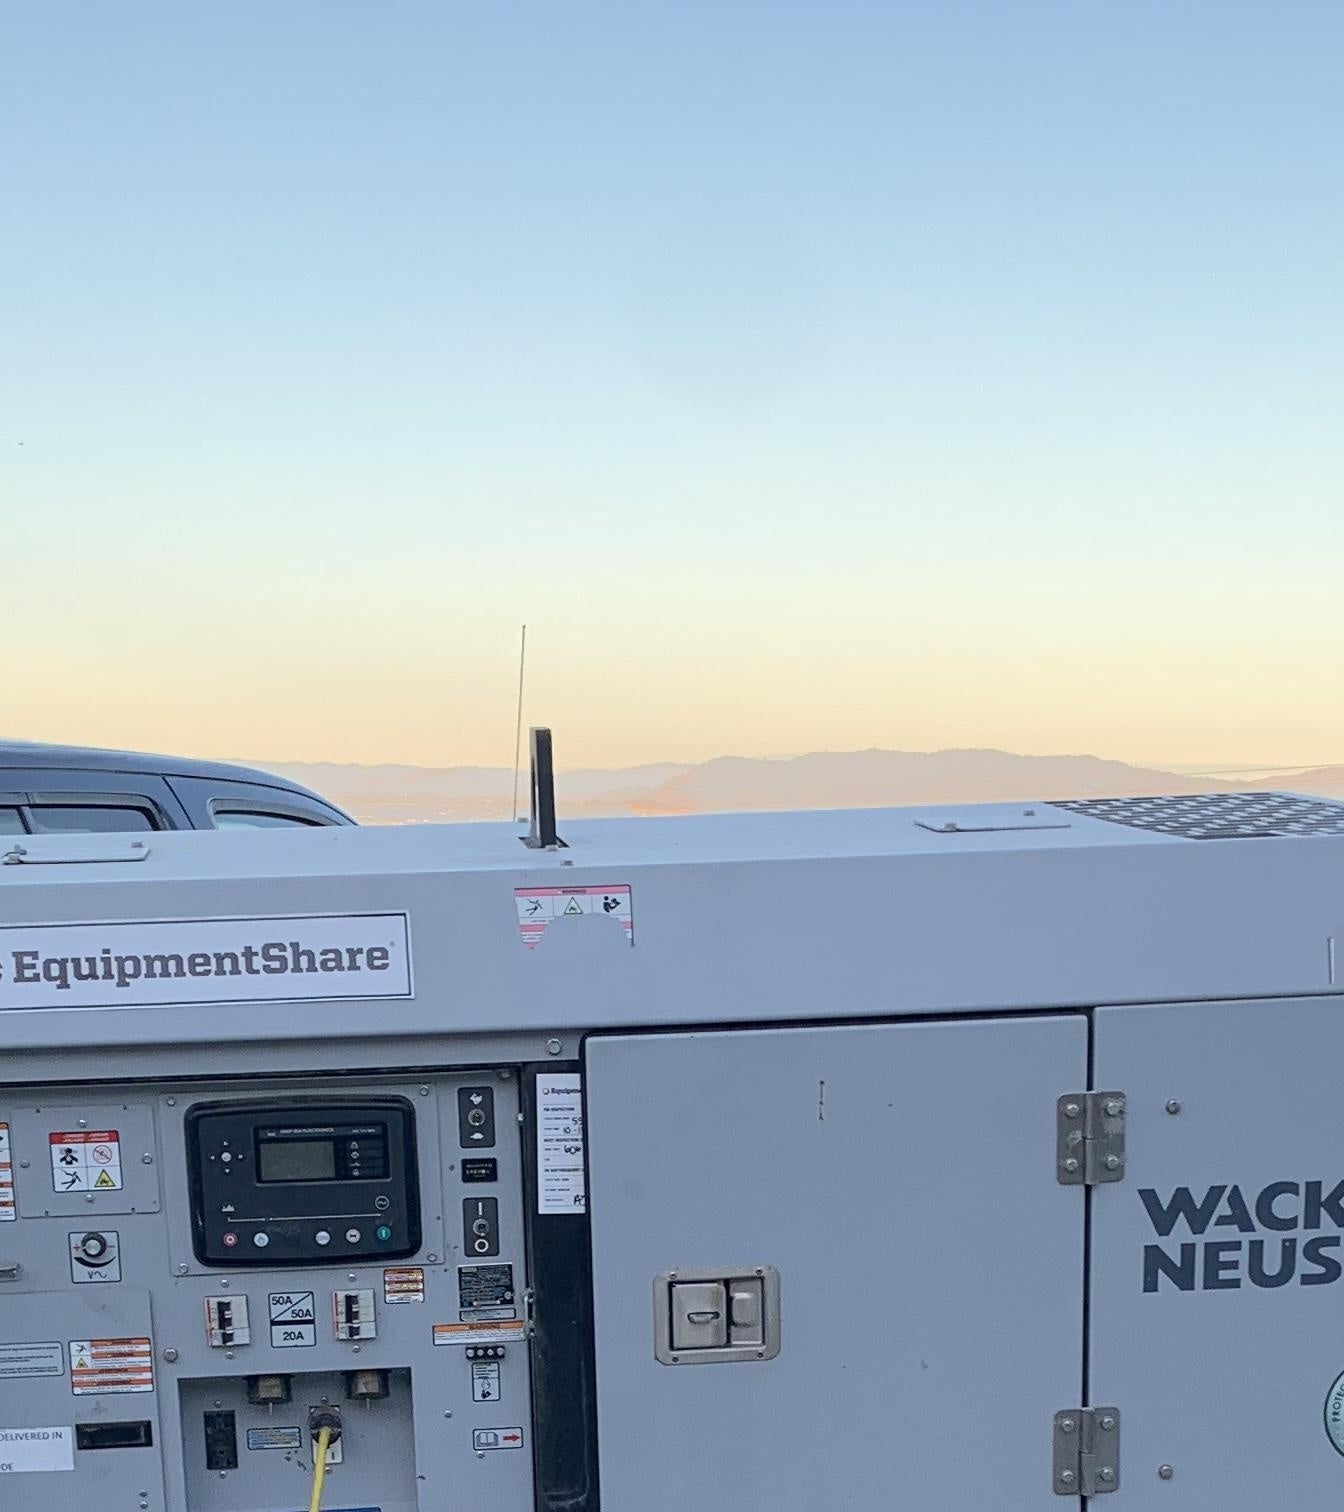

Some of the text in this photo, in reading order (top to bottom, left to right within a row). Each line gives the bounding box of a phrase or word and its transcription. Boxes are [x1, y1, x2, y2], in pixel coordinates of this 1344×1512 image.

[12, 941, 390, 989] EquipmentShare
[272, 1296, 292, 1305] 50A
[291, 1309, 312, 1318] 50A
[283, 1331, 304, 1341] 20A
[52, 1431, 63, 1440] IN
